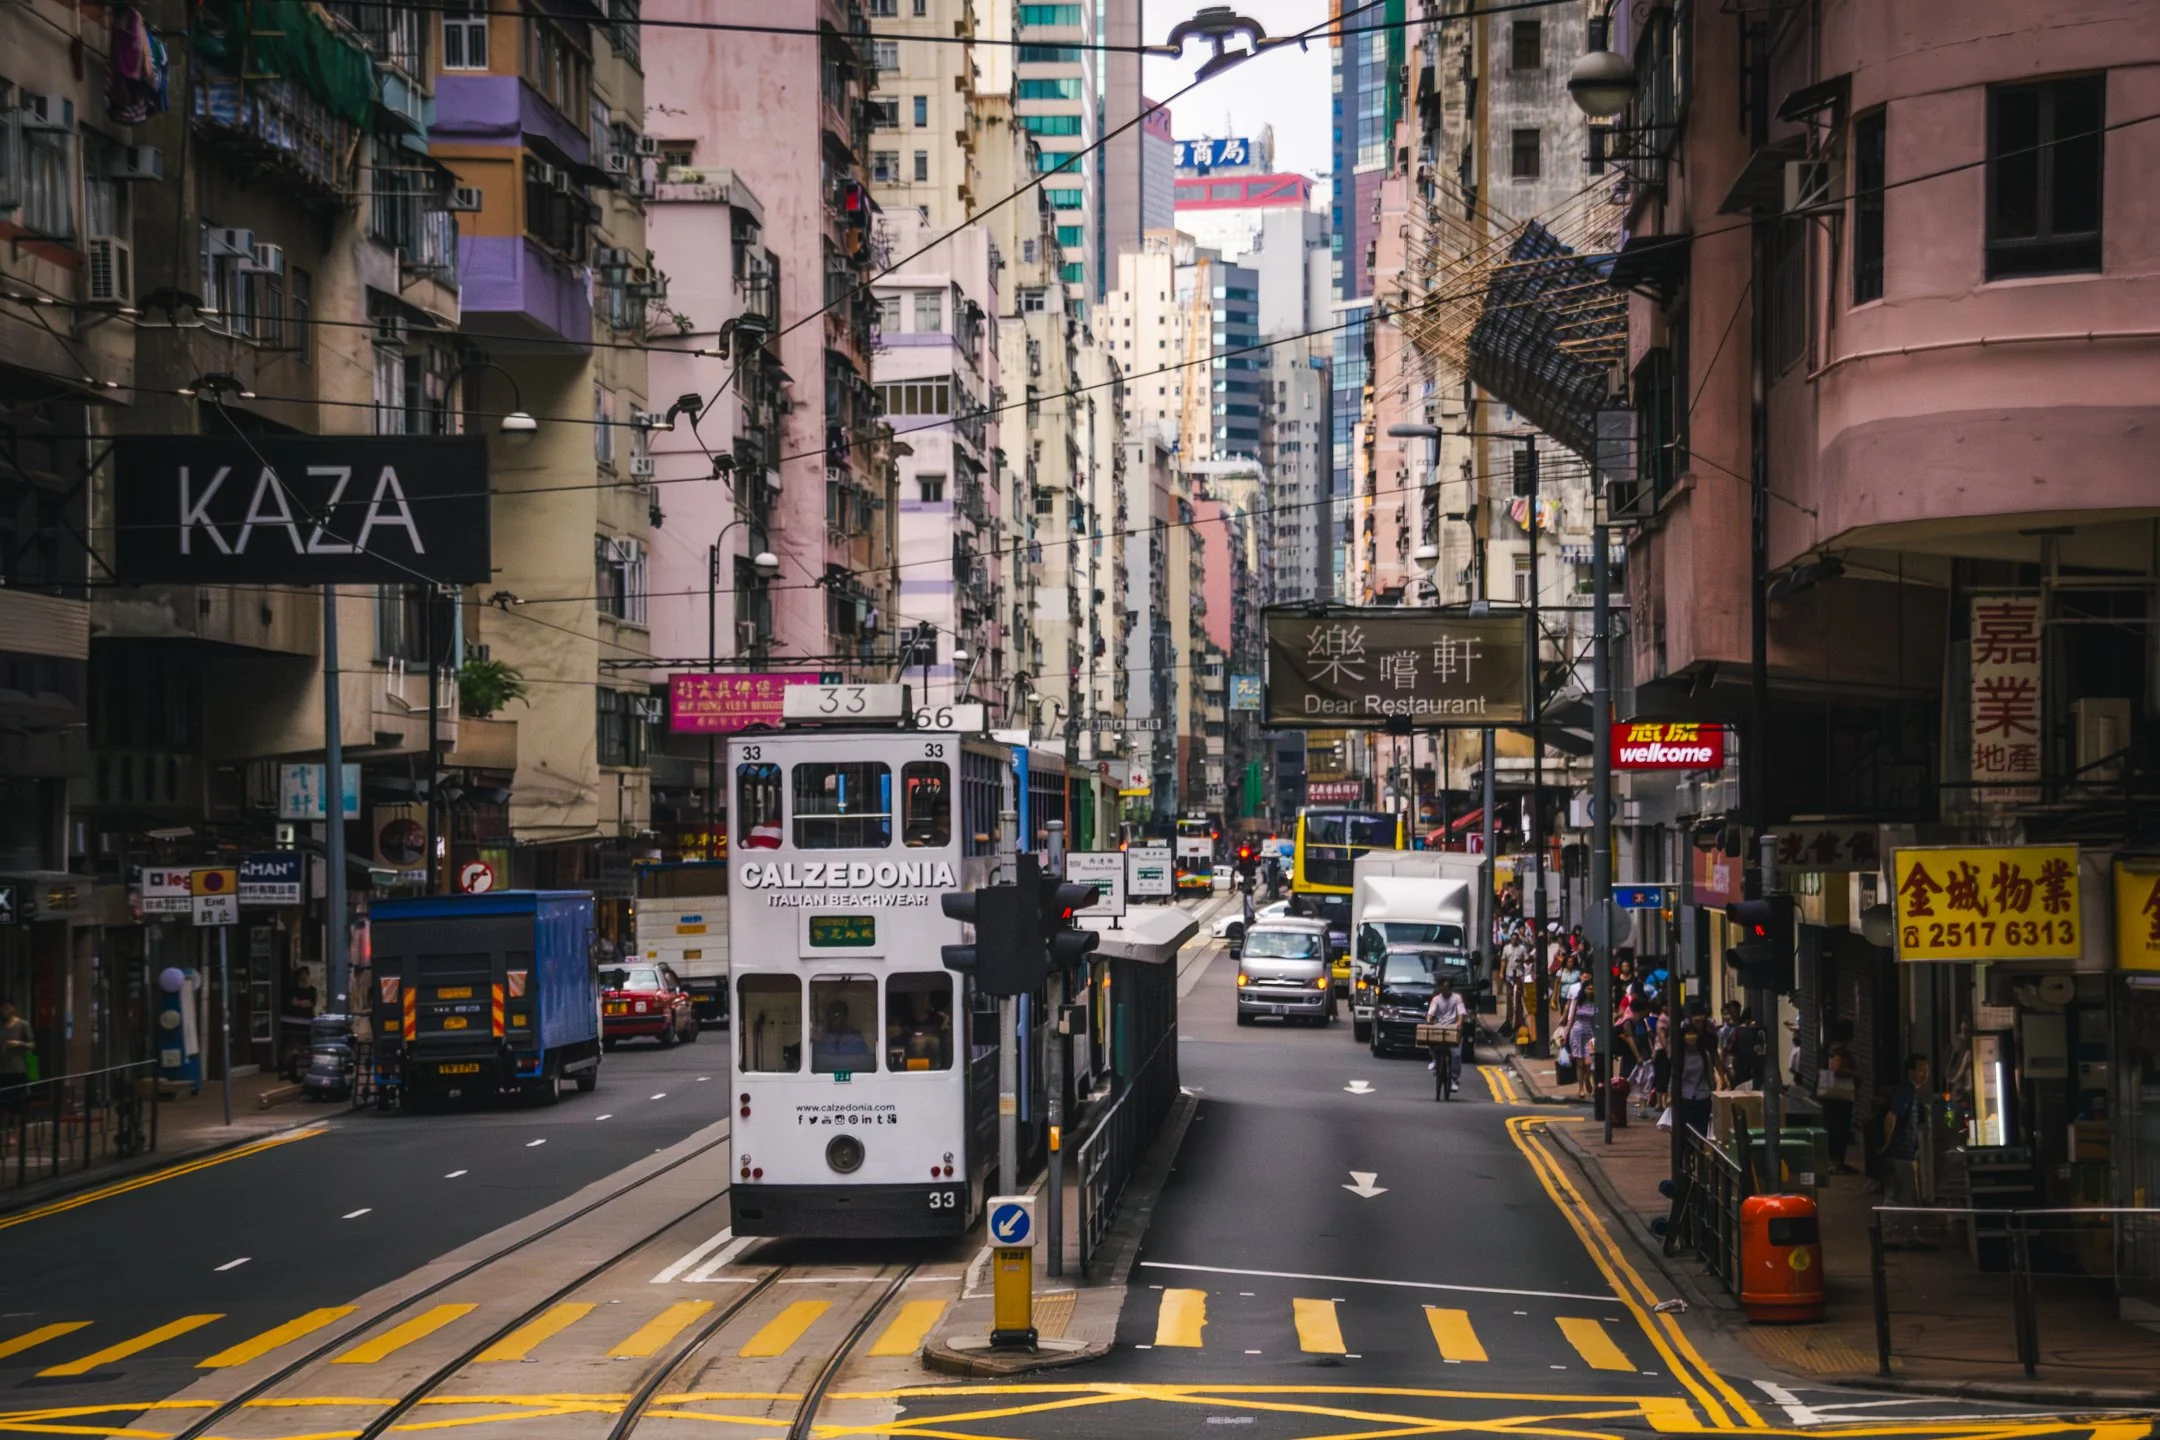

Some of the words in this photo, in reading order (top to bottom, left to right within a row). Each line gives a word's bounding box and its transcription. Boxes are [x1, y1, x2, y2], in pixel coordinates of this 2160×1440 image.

[178, 465, 426, 554] KAZA
[1306, 624, 1483, 690] 樂嚐軒
[1973, 602, 2042, 738] 嘉業
[819, 686, 866, 714] 33
[1304, 694, 1358, 714] Dear
[1364, 694, 1487, 714] Restaurant
[914, 706, 954, 728] 66
[742, 745, 761, 760] 33
[924, 743, 944, 758] 33
[1619, 742, 1713, 763] wellcome
[1974, 743, 2039, 773] 地產
[739, 860, 957, 889] CALZEDONIA
[1898, 858, 2075, 918] 金城物業
[205, 897, 226, 907] End
[768, 893, 827, 907] ITALIAN
[828, 892, 928, 907] BEACHWEAR
[1929, 921, 1997, 948] 2517
[2004, 919, 2075, 946] 6313
[796, 1103, 896, 1112] www.calzedonia.com
[929, 1191, 955, 1208] 33
